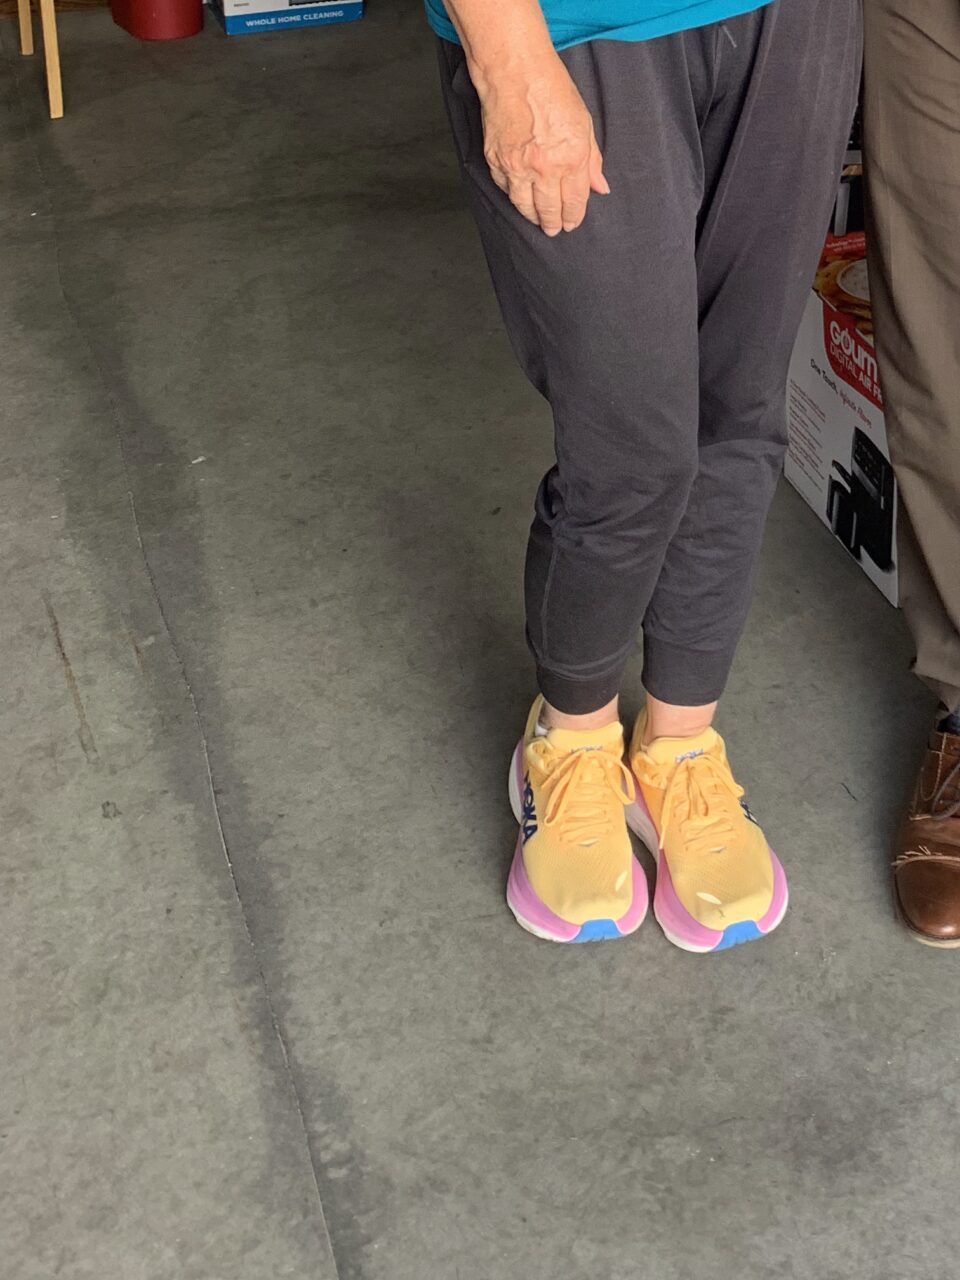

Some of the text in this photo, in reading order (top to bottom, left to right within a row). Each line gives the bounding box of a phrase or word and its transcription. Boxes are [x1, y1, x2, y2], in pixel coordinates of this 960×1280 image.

[246, 11, 344, 27] WHOLE HOME CLEANING
[830, 341, 872, 393] DIGITAL AIR
